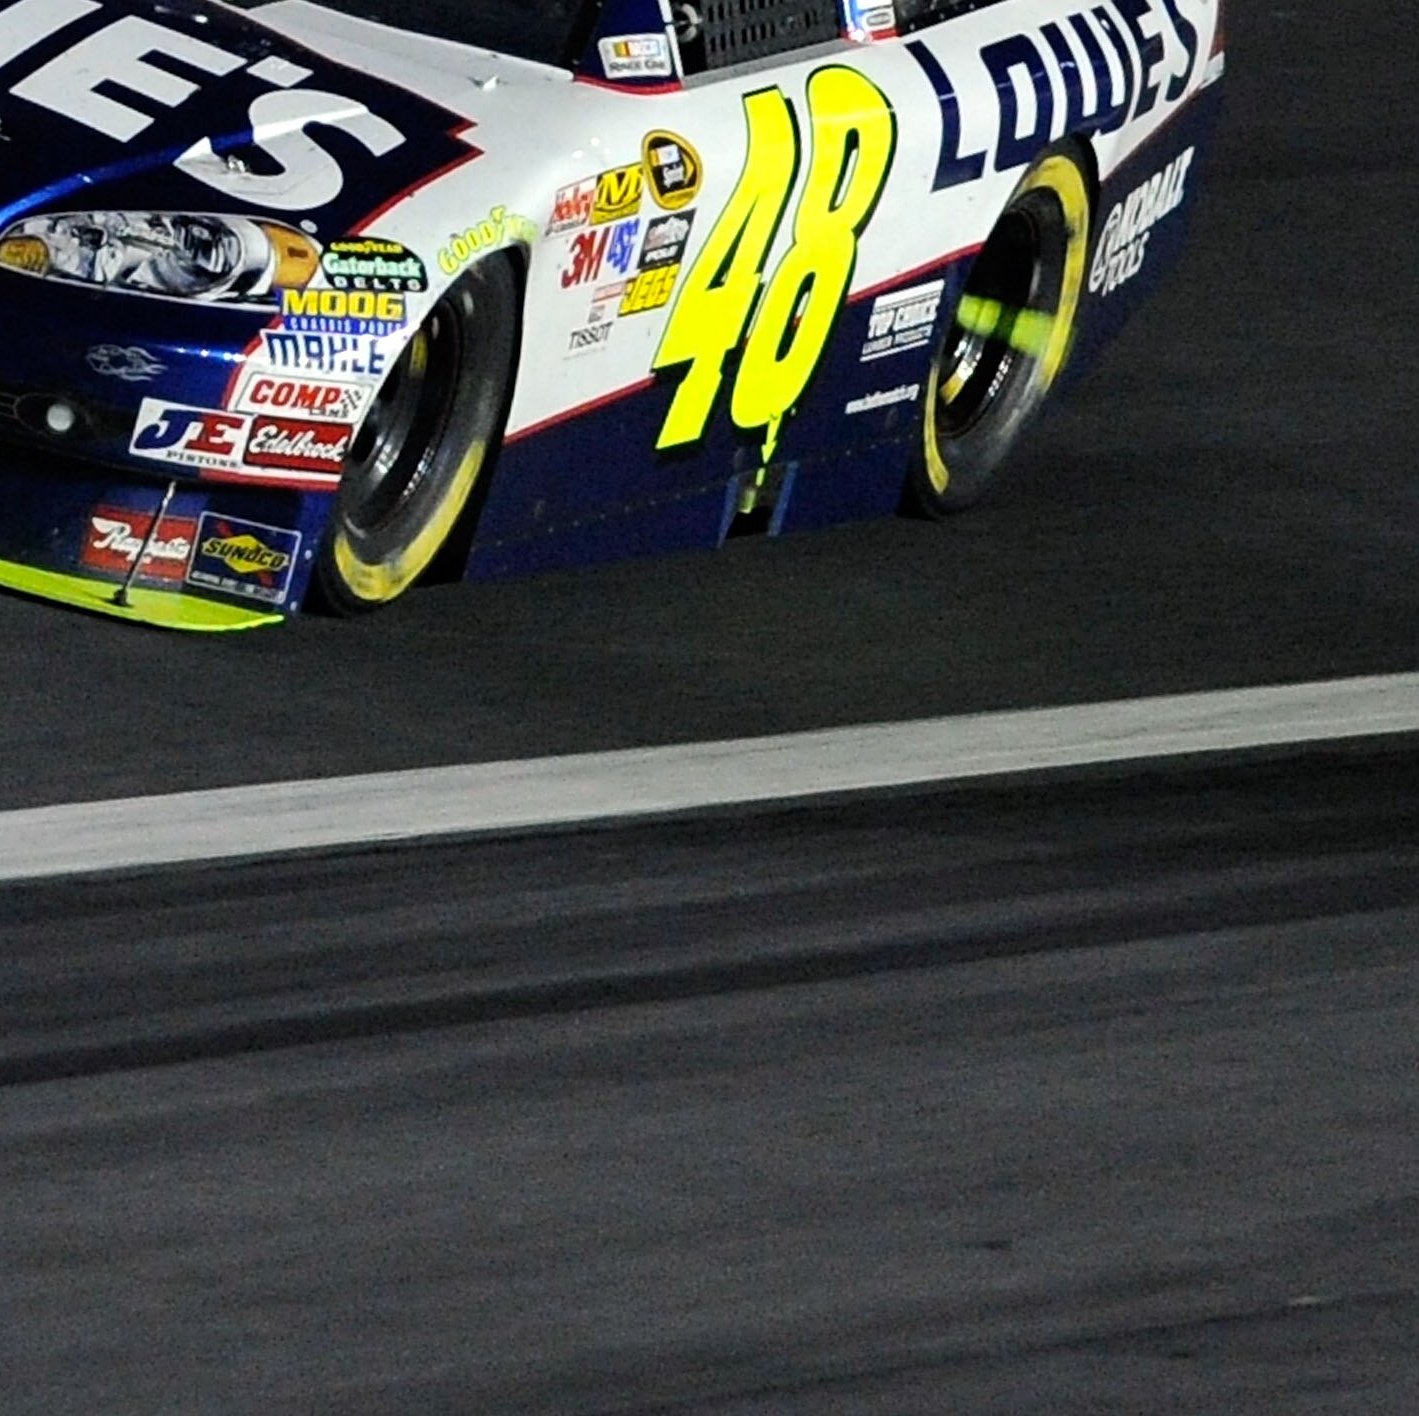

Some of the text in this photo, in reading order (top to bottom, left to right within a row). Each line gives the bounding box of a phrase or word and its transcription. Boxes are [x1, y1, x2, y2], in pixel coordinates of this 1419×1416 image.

[322, 251, 422, 279] Gatorback
[561, 226, 611, 289] 3M
[652, 64, 896, 450] 48
[283, 289, 404, 321] MOOG
[265, 332, 385, 375] MAHLE
[249, 379, 341, 410] COMP
[133, 408, 246, 456] JE
[248, 425, 348, 462] Edelbrock
[165, 448, 238, 469] PISTONS
[203, 538, 291, 570] SUNOCO
